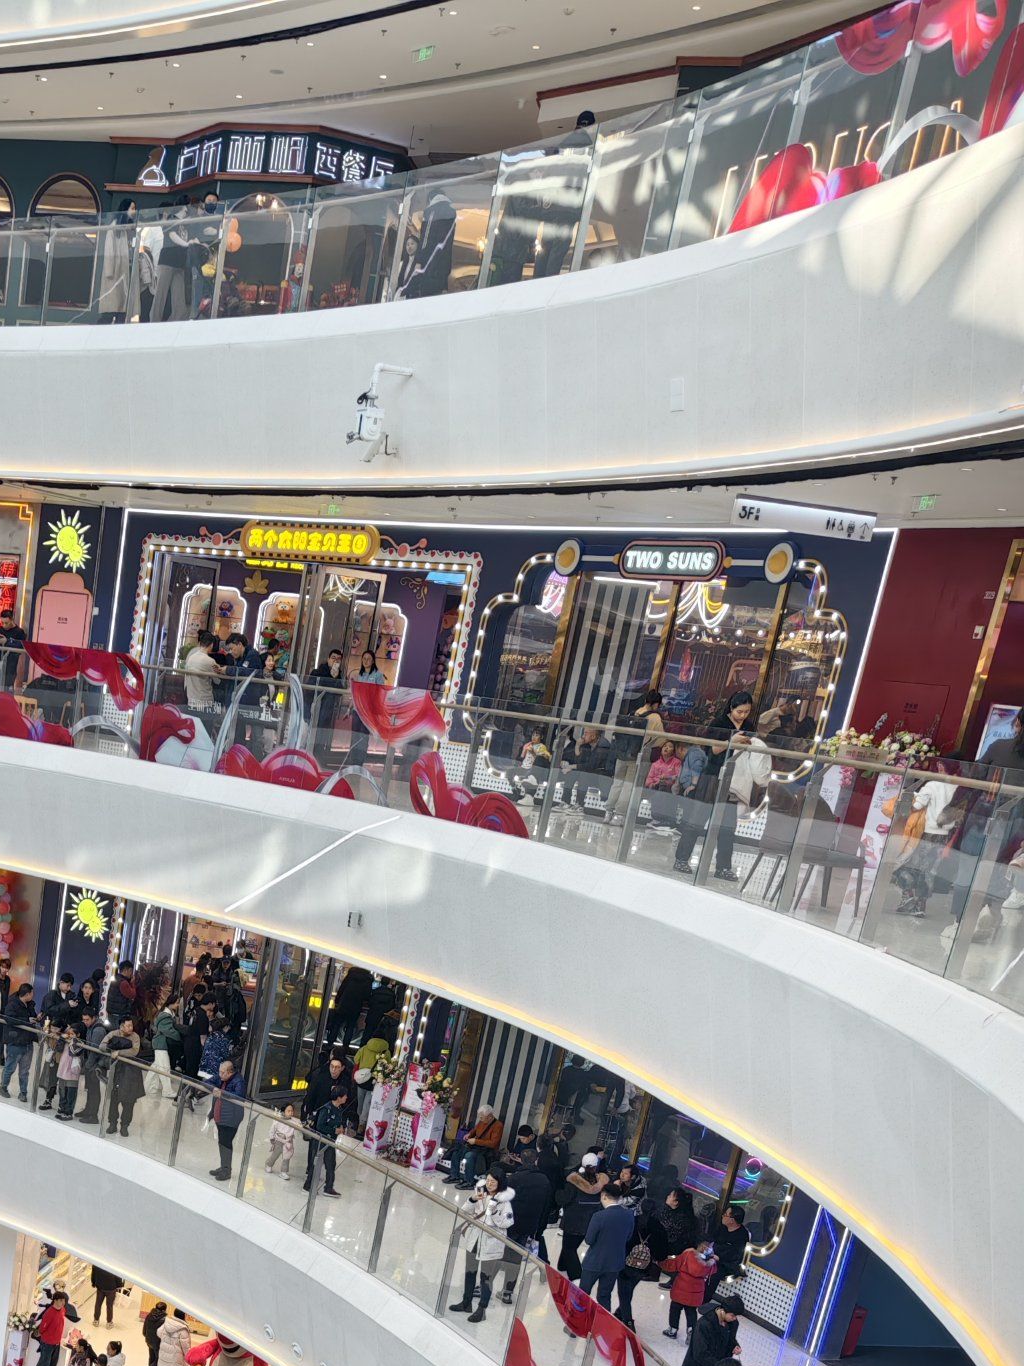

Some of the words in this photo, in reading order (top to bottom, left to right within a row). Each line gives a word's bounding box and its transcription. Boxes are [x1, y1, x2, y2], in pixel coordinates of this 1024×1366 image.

[739, 506, 755, 520] 3F
[626, 550, 662, 569] TWO
[666, 551, 714, 571] SUNS
